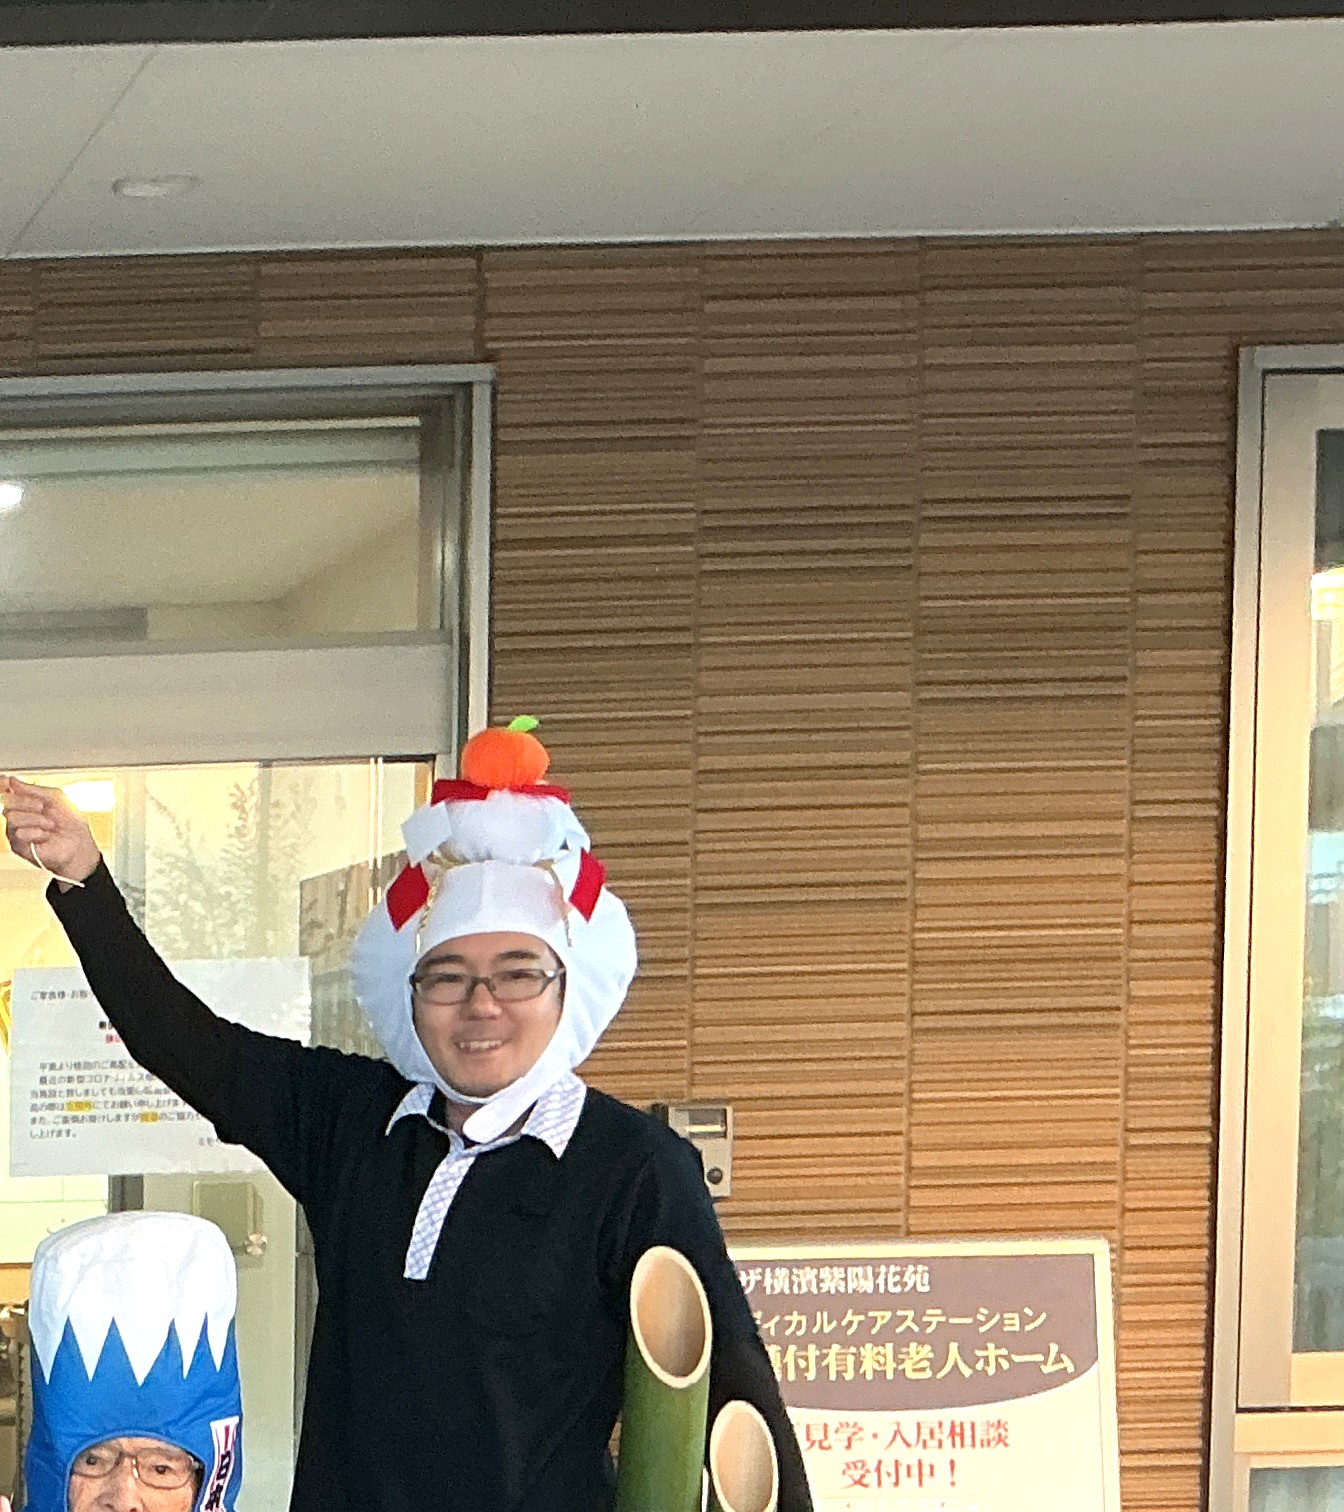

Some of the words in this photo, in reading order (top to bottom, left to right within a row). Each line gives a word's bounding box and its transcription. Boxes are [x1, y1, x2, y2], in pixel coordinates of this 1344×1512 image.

[797, 1418, 1010, 1451] 見学・入居相談
